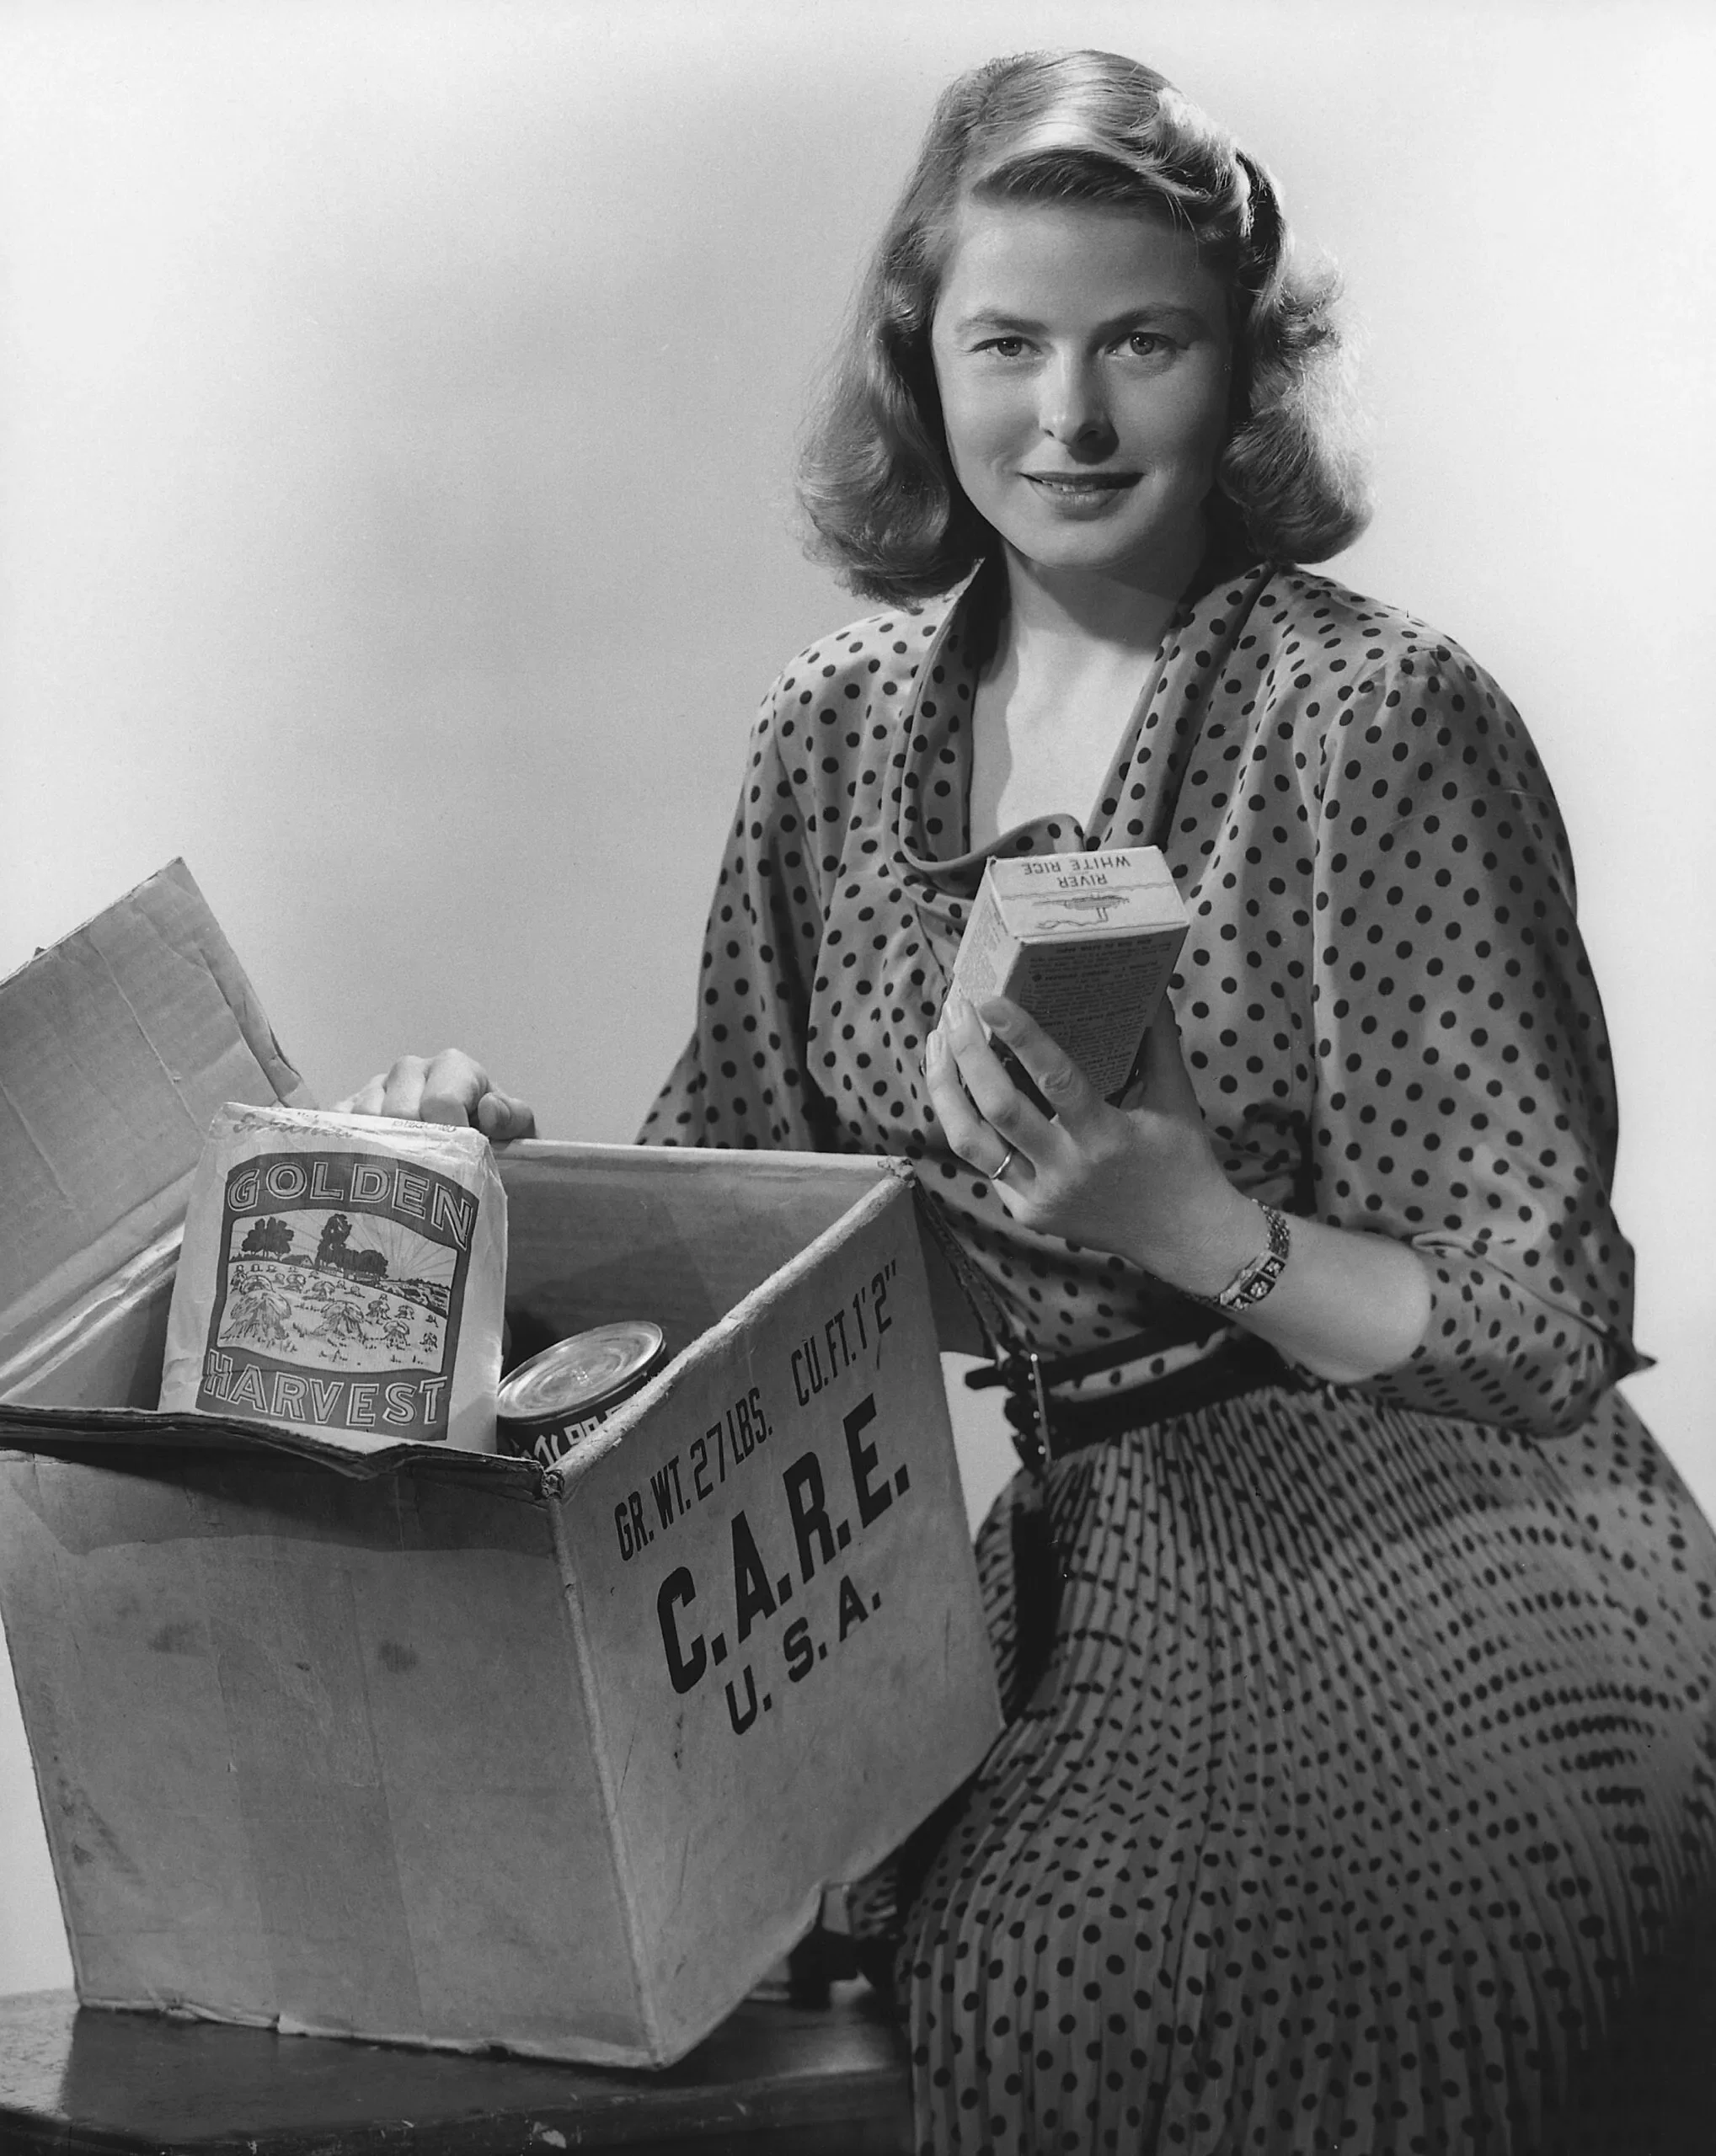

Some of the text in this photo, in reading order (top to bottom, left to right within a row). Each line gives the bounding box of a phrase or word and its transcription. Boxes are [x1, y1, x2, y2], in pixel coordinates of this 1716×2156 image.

[1022, 856, 1131, 875] WHITE RICE
[1057, 874, 1108, 889] RIVER
[228, 1162, 473, 1251] GOLDEN
[204, 1349, 448, 1426] HARVEST
[657, 1393, 910, 1694] C.A.R.E.
